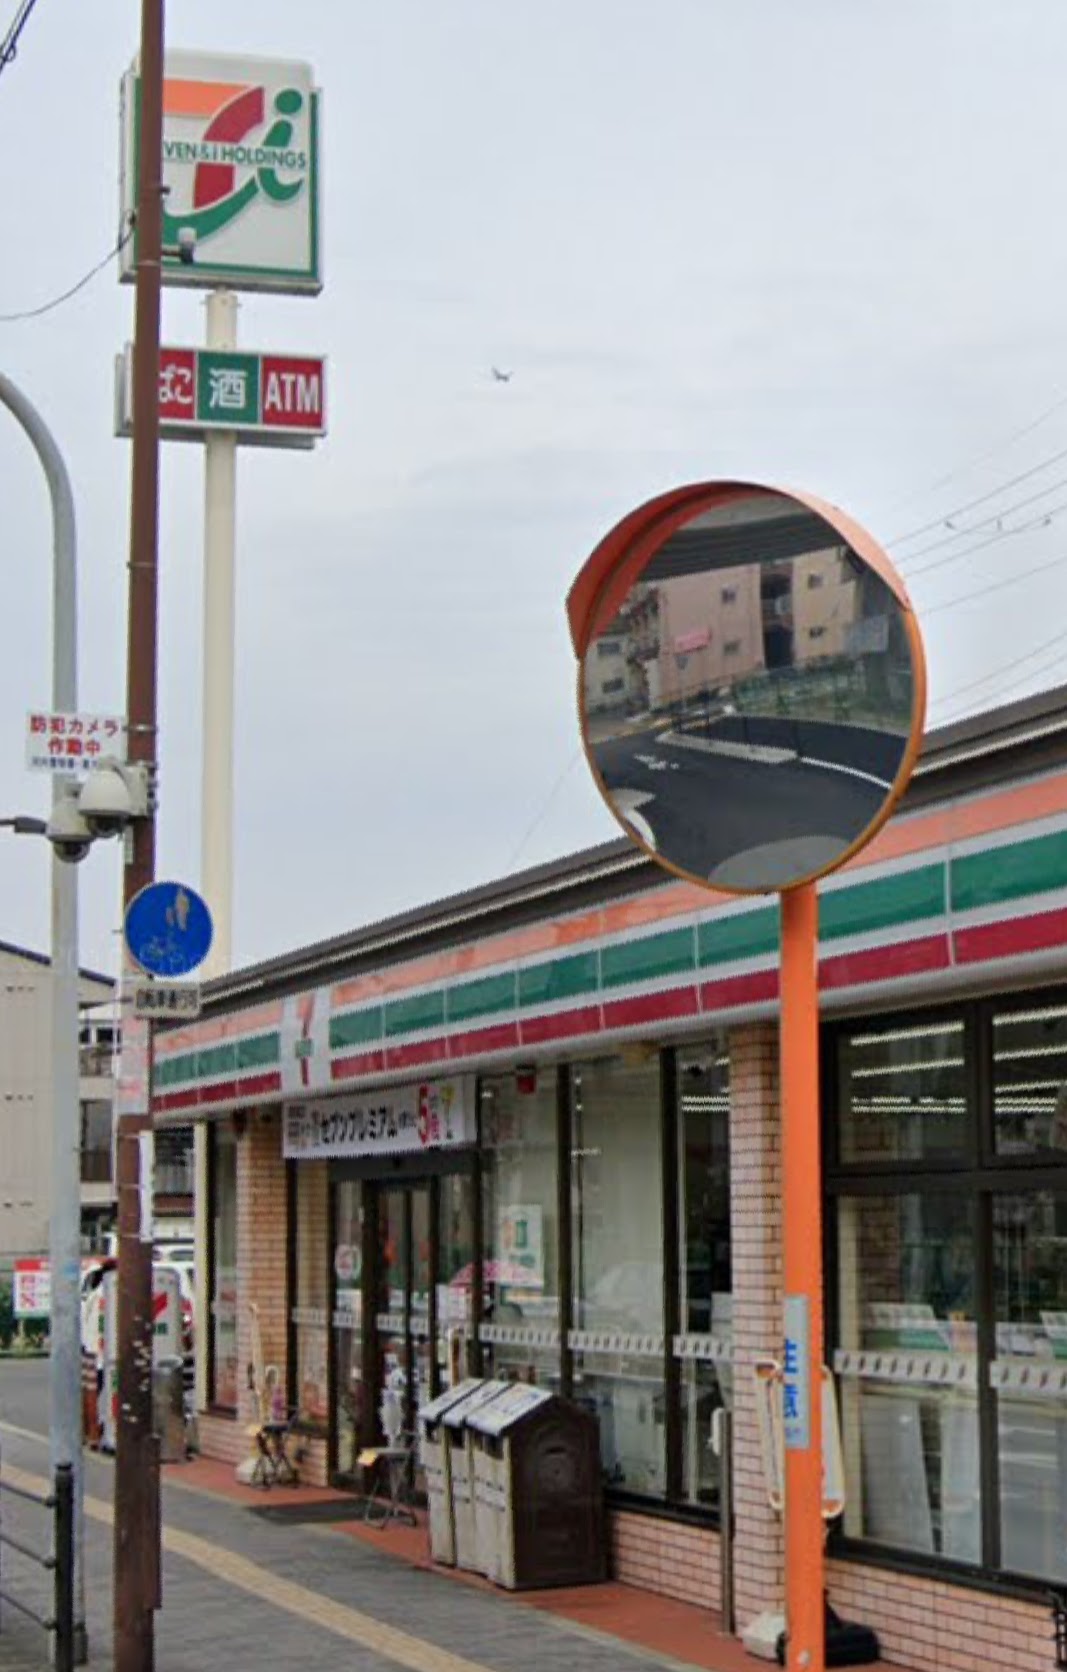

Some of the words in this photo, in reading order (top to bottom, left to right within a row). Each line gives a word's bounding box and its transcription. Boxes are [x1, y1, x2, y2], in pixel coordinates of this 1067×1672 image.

[163, 142, 196, 160] VEN
[221, 145, 306, 168] HOLDINGS
[159, 363, 193, 404] ばこ
[209, 367, 247, 409] 酒
[265, 371, 320, 413] ATM
[30, 714, 118, 738] 防犯カメラ
[47, 736, 101, 756] 作動中
[321, 1104, 398, 1144] セブンプレミアム
